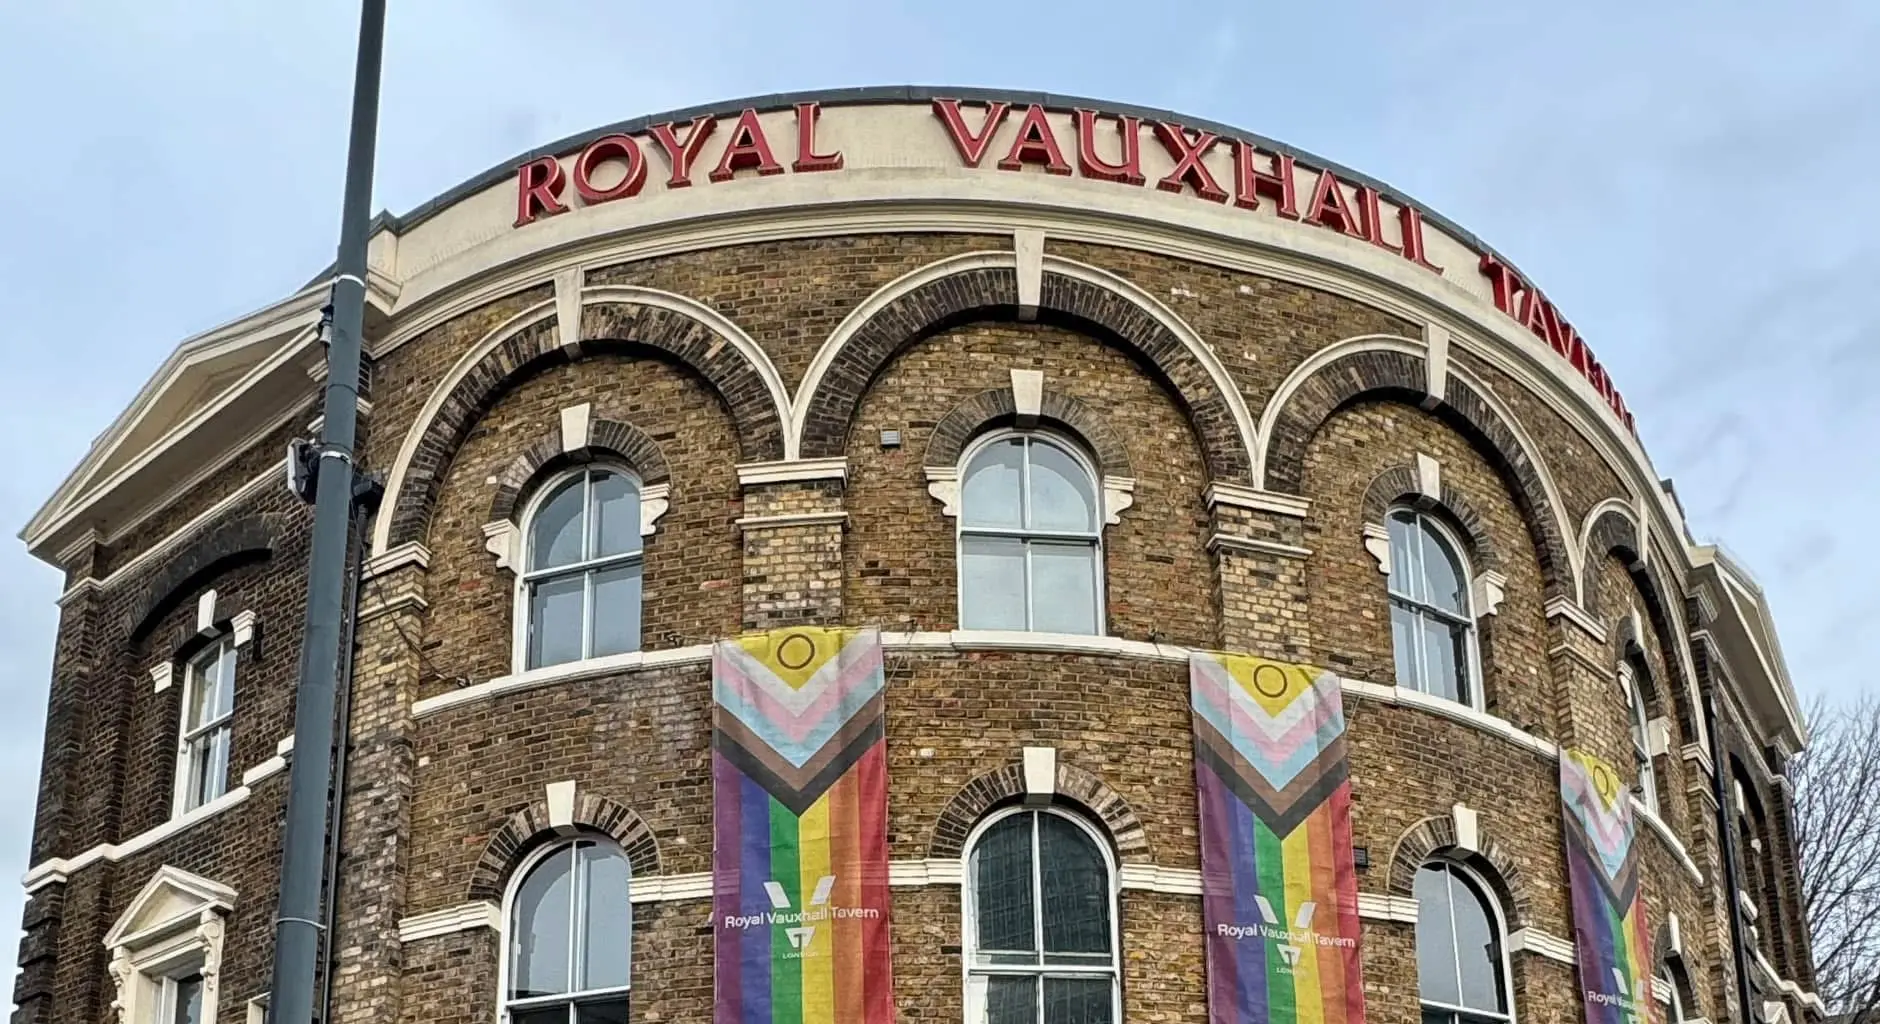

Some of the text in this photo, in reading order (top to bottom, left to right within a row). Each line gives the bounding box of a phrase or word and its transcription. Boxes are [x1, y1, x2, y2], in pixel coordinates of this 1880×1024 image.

[512, 101, 844, 228] ROYAL
[931, 97, 1444, 275] VAUXHALL
[725, 906, 879, 930] Royal Vauxhall Tavern
[1217, 923, 1355, 948] Royal Vauxhall Tavern
